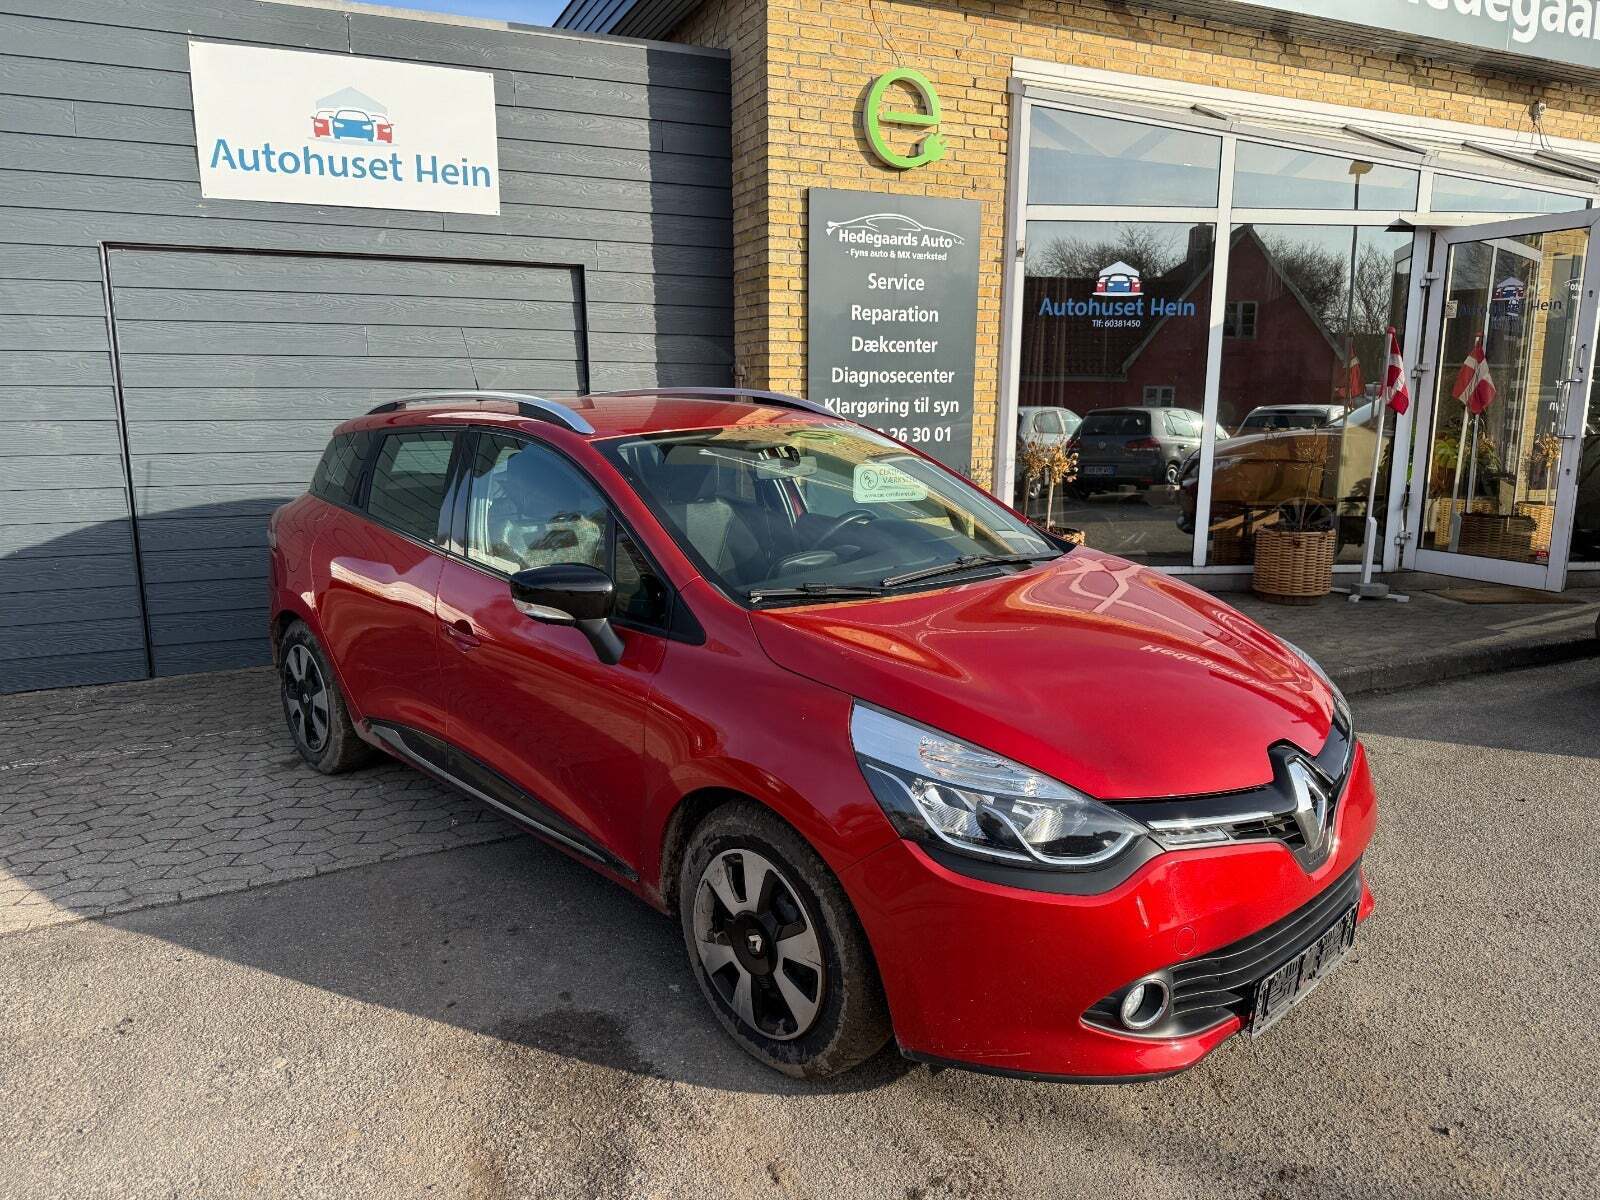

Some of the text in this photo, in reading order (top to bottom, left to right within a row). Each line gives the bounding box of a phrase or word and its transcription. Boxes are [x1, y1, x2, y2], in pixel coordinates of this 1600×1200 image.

[210, 139, 491, 188] Autohuset Hein
[838, 229, 952, 248] Hedegaards Auto
[850, 248, 868, 258] Fyns
[870, 250, 888, 258] auto
[890, 250, 896, 258] &
[897, 251, 911, 259] MX
[912, 252, 947, 261] værksted
[868, 273, 925, 291] Service
[851, 304, 939, 324] Reparation
[1039, 297, 1195, 316] Autohuset Hein
[851, 336, 938, 353] Dækcenter
[831, 367, 955, 387] Diagnosecenter
[824, 397, 959, 417] Klargøring til syn
[912, 427, 931, 442] 30
[934, 427, 951, 442] 01
